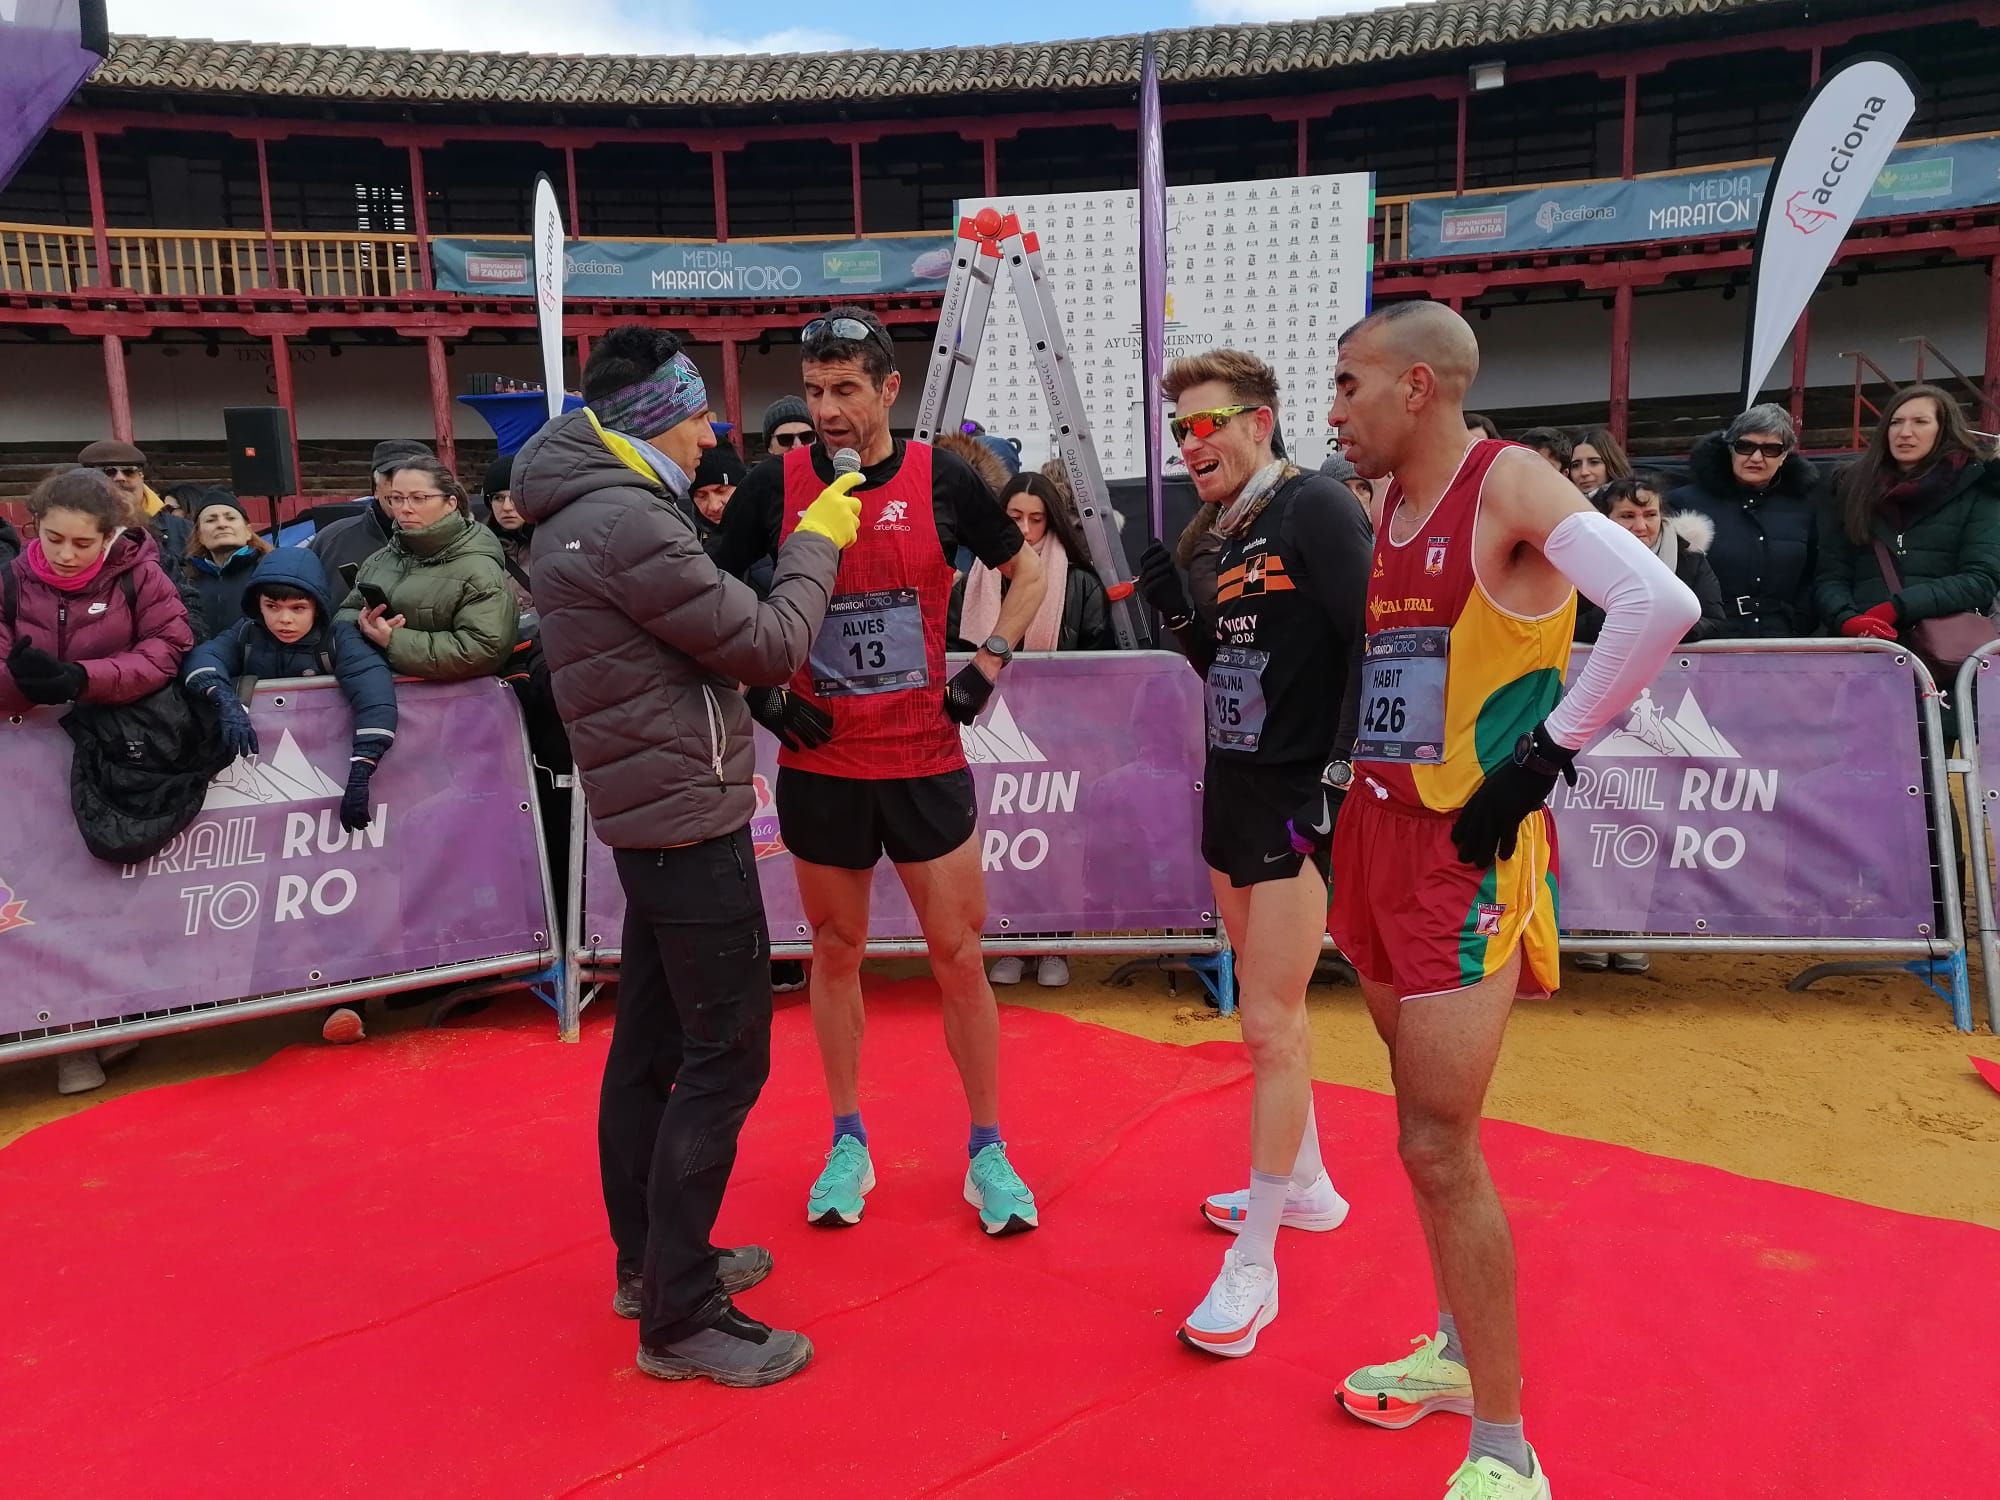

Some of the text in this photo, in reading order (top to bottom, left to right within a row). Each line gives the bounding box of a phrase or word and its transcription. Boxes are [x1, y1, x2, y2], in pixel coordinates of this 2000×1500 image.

[1812, 96, 1887, 205] acciona
[1688, 175, 1751, 202] MEDIA
[1552, 204, 1617, 223] acciona
[1648, 196, 1750, 231] MARATÓN
[1456, 223, 1502, 235] ZAMORA
[545, 211, 555, 289] acciona
[682, 250, 733, 268] MEDIA
[480, 269, 524, 279] ZAMORA
[568, 260, 624, 276] acciona
[652, 265, 802, 291] MARATÓN TORO
[1066, 448, 1091, 504] FOTOGRAFO
[863, 595, 893, 608] TORO
[842, 618, 885, 637] ALVES
[1223, 614, 1258, 633] VICKY
[848, 640, 886, 670] 13
[1393, 639, 1417, 653] TORO
[1373, 668, 1403, 689] HABIT
[1364, 696, 1407, 734] 426
[989, 770, 1080, 815] RUN
[1678, 768, 1778, 811] RUN
[281, 803, 388, 859] RUN
[981, 828, 1049, 872] RO
[1590, 824, 1746, 870] TO RO
[180, 868, 358, 936] TO RO
